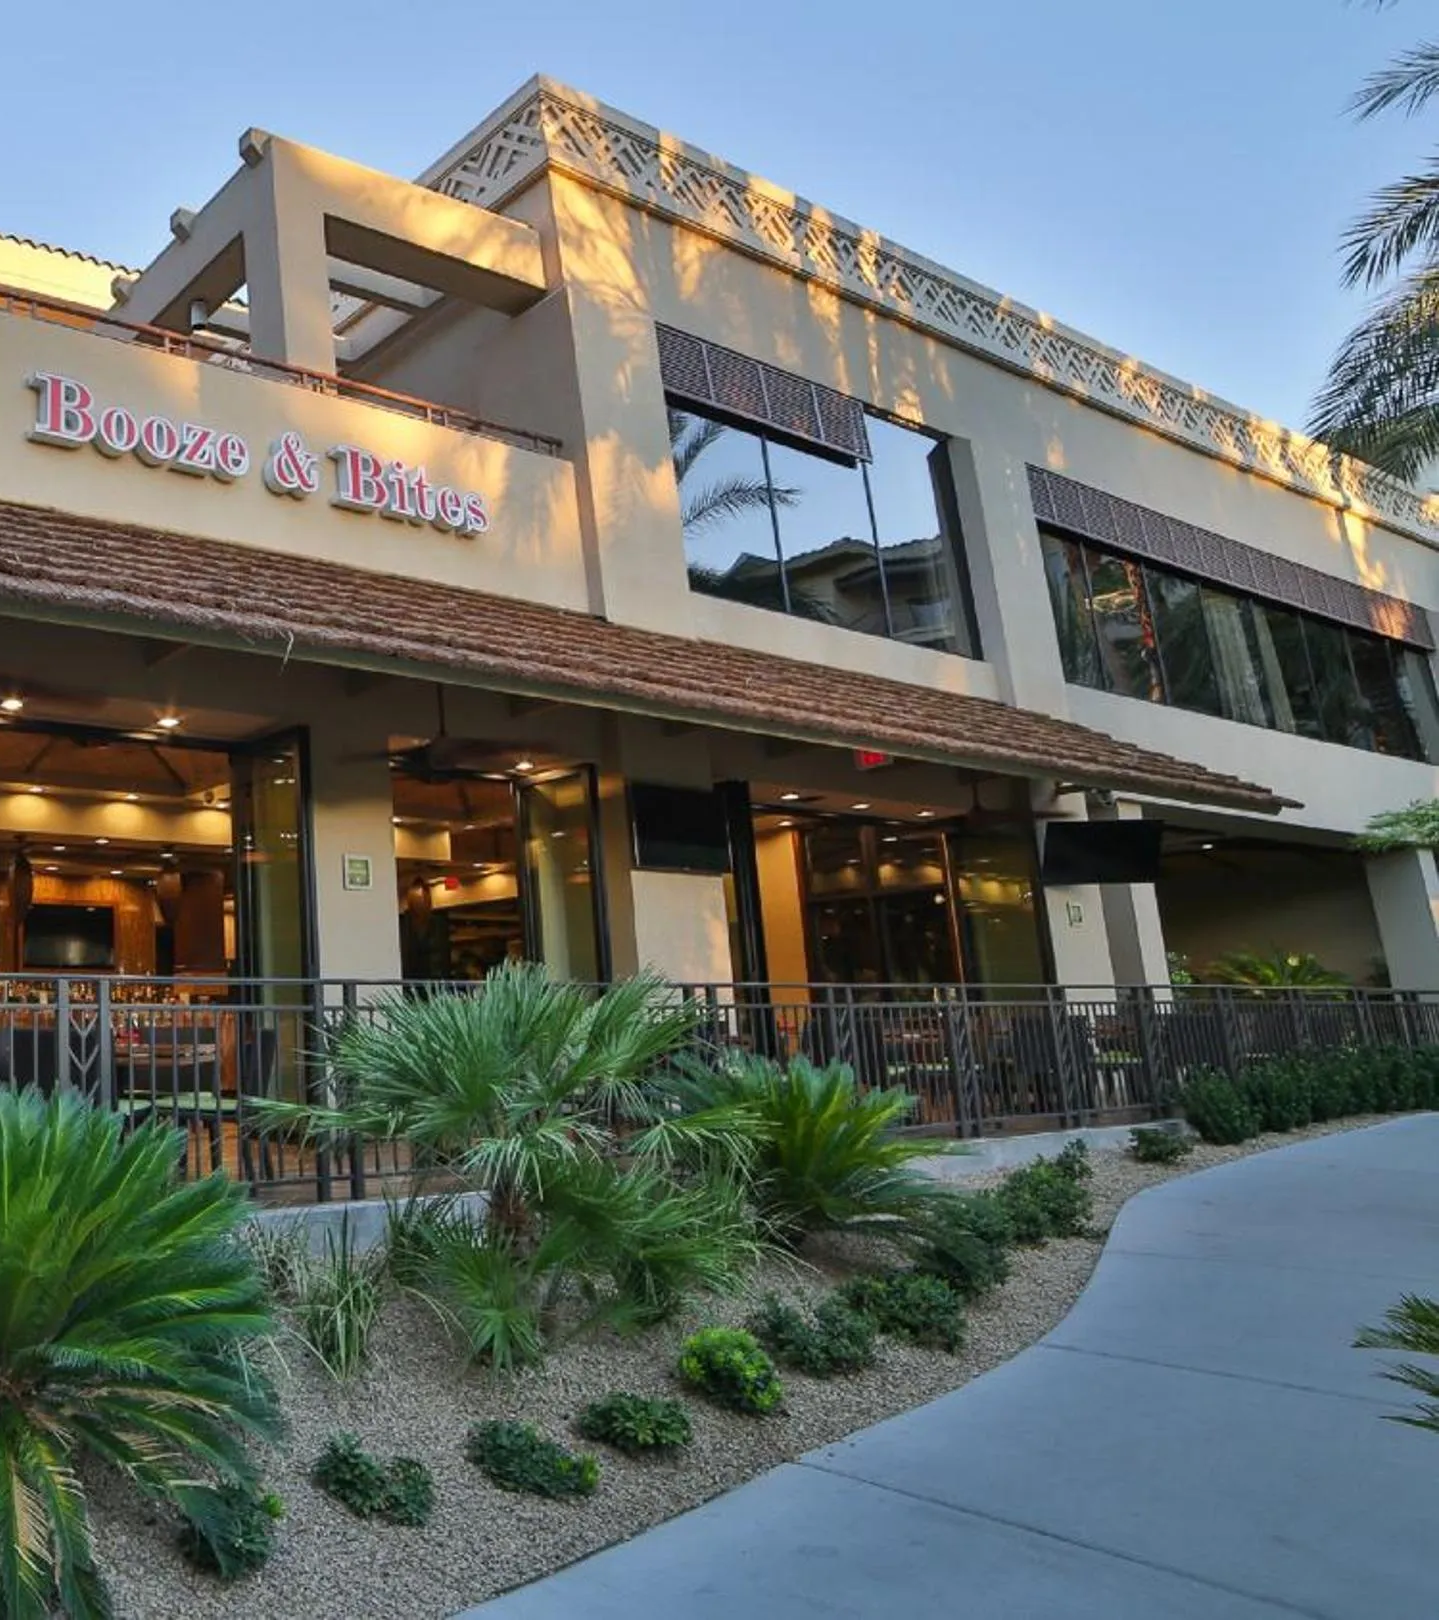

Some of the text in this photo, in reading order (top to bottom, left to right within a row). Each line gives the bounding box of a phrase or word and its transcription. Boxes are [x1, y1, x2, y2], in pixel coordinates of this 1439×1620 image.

[29, 370, 490, 534] Booze & Bites
